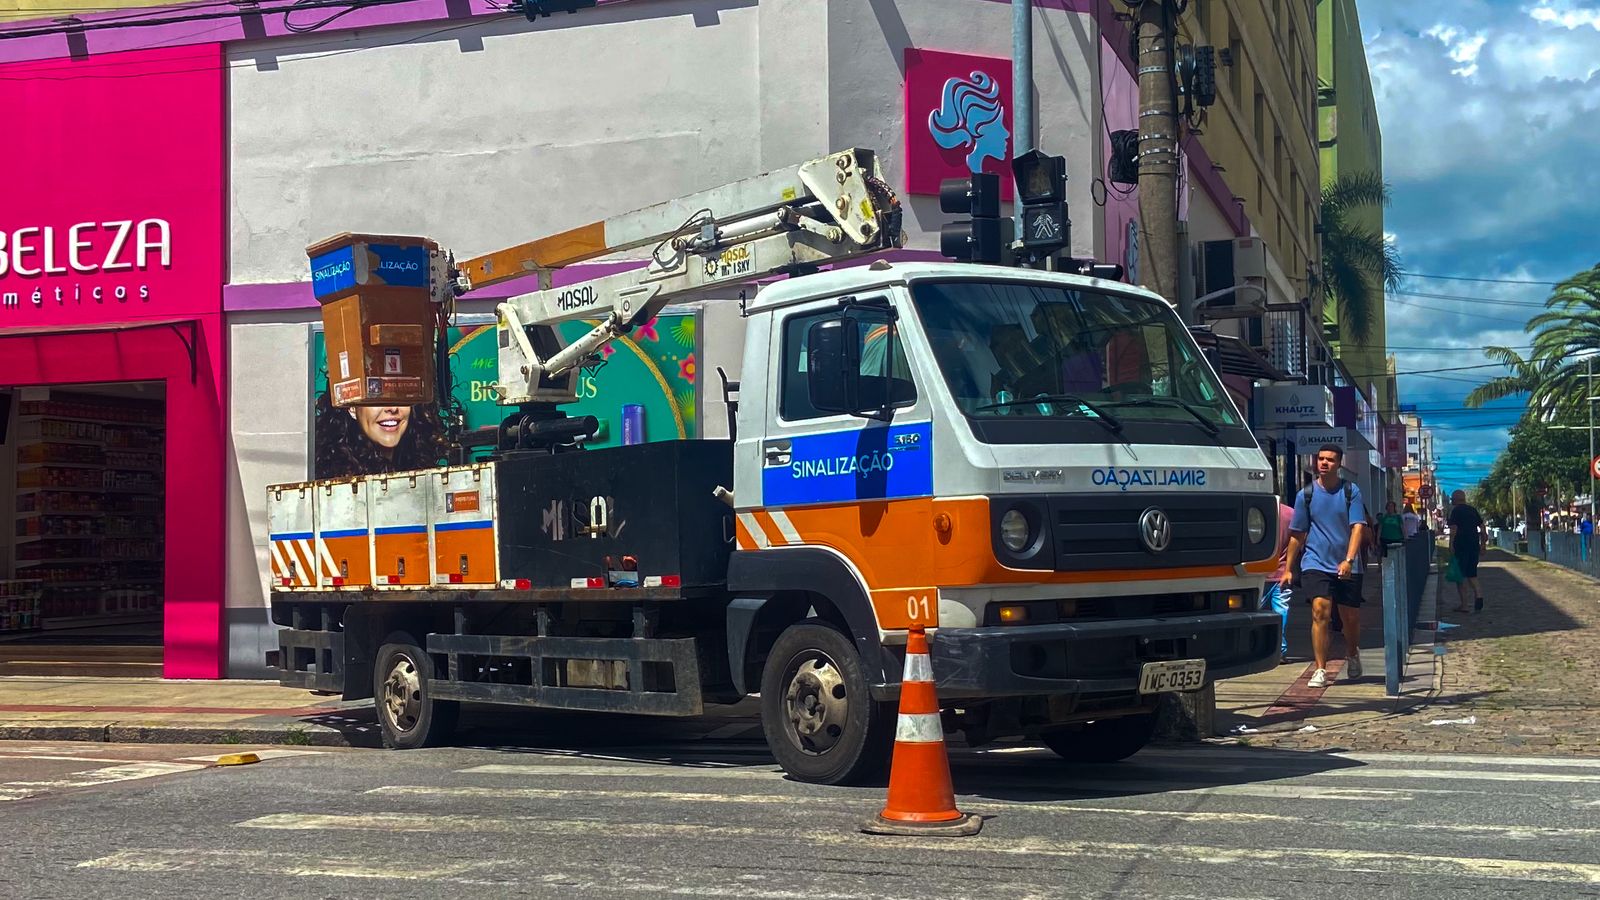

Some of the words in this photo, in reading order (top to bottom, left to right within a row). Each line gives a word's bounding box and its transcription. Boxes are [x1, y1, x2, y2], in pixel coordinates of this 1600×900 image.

[314, 261, 351, 282] SINALIZAÇÃO
[379, 261, 419, 272] LIZAÇÃO
[557, 285, 599, 311] MASAL
[1275, 405, 1315, 413] KHAUTZ
[792, 450, 894, 479] SINALIZAÇÃO
[907, 596, 930, 620] 01
